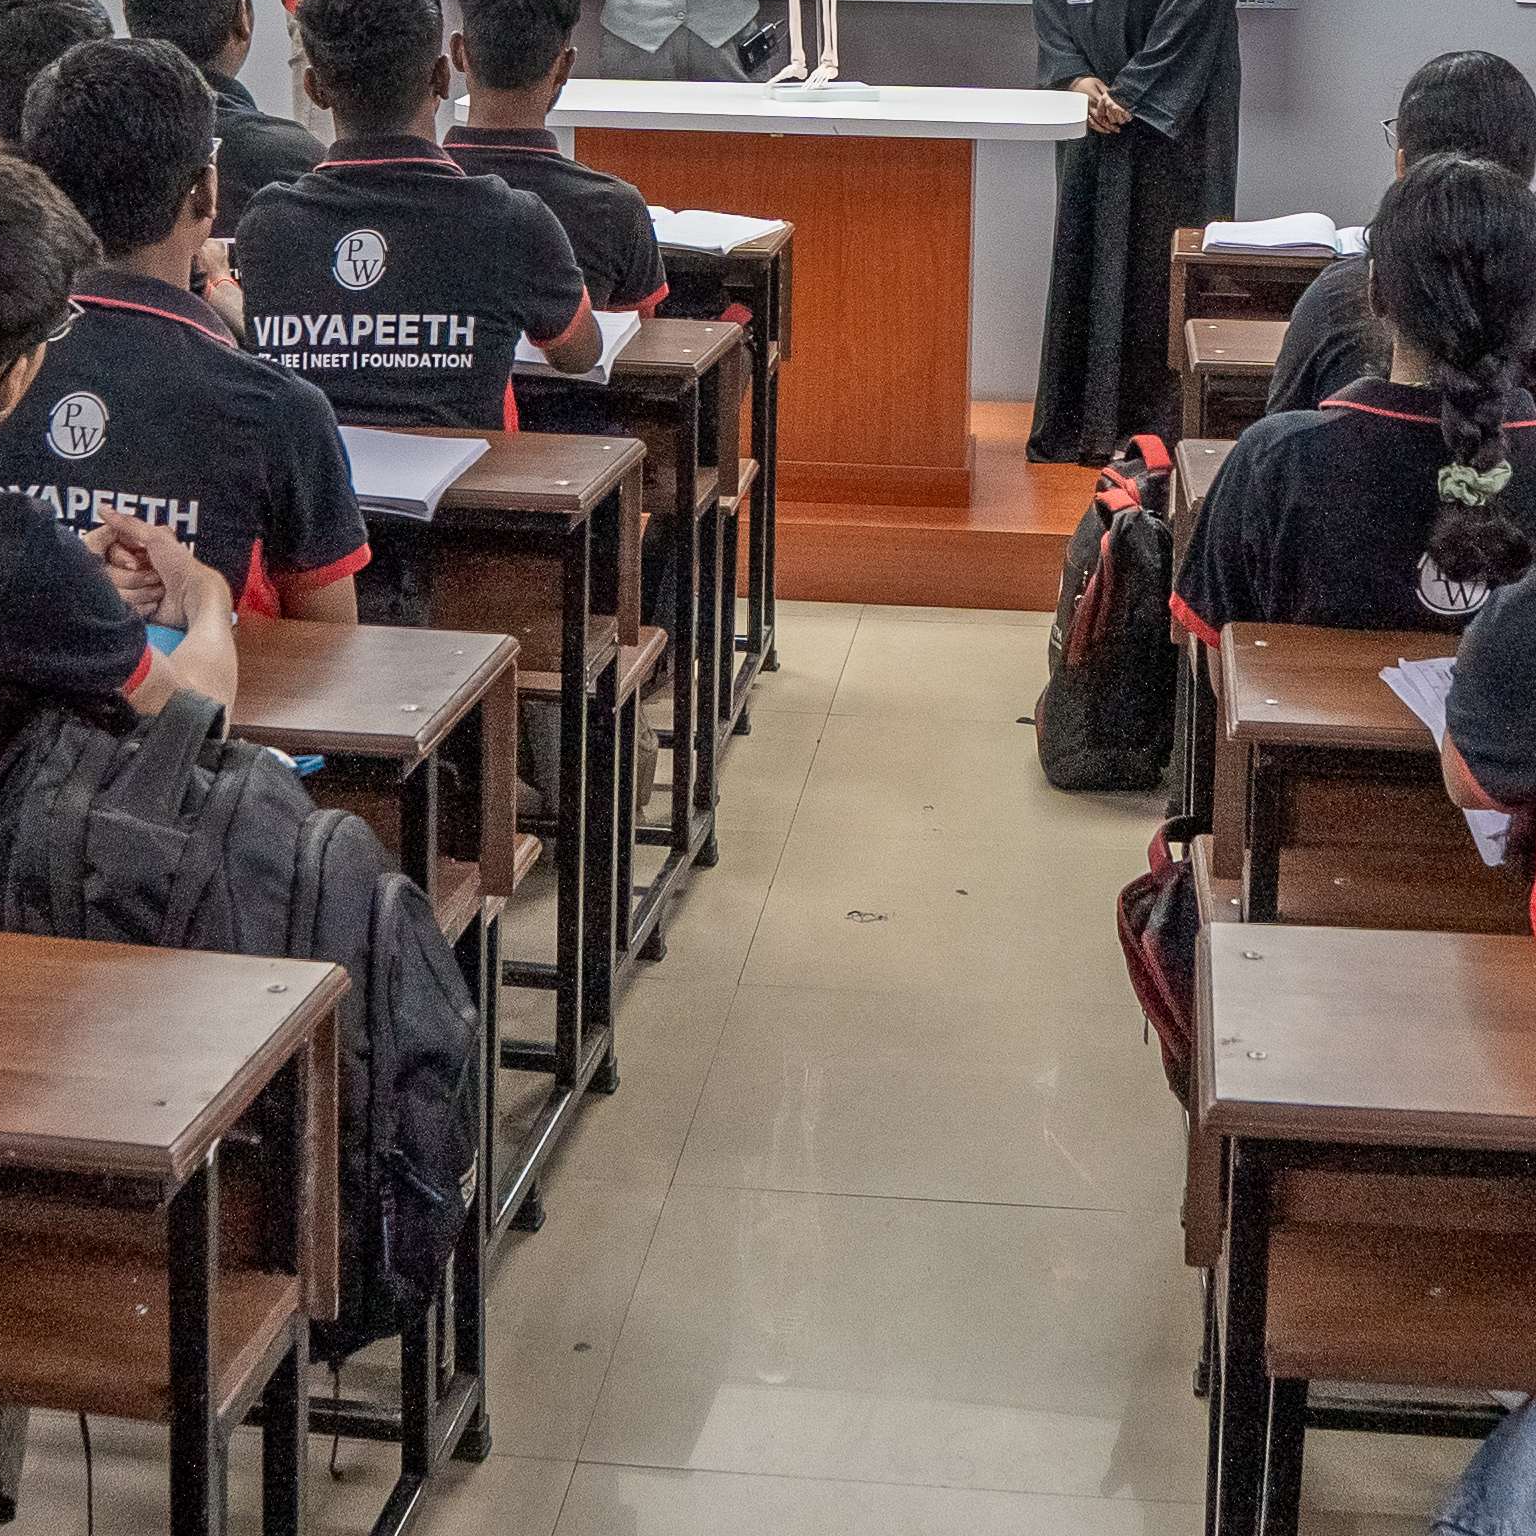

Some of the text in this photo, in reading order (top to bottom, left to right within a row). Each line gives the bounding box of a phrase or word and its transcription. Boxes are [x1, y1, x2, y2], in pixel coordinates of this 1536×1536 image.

[254, 314, 475, 347] VIDYAPEETH
[310, 354, 350, 368] NEET
[362, 354, 473, 368] FOUNDATION
